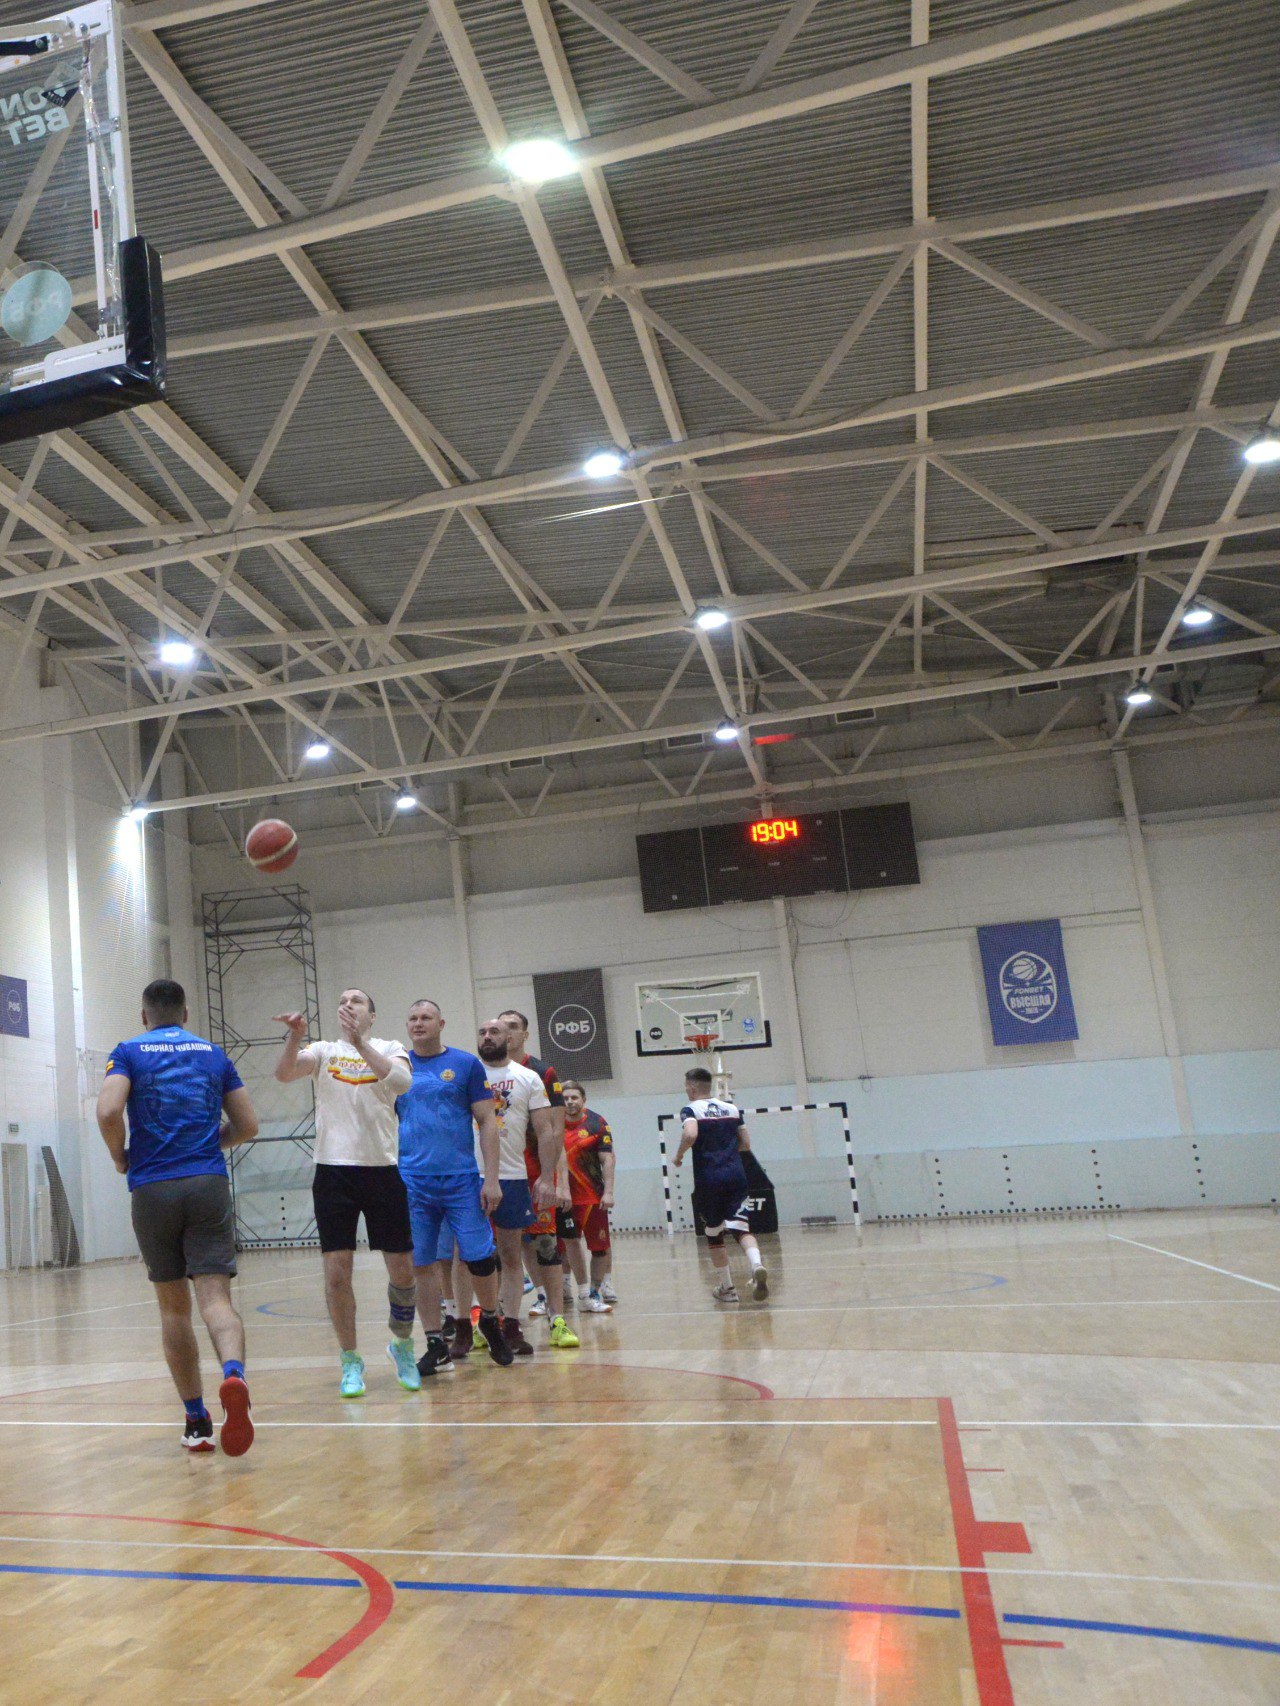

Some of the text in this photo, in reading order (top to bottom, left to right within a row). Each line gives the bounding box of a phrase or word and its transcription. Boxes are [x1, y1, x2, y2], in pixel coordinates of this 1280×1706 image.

[751, 820, 798, 842] 19:04
[555, 1020, 590, 1035] РФБ
[140, 1042, 213, 1053] СБОРНАЯ ЧУВАШИИ
